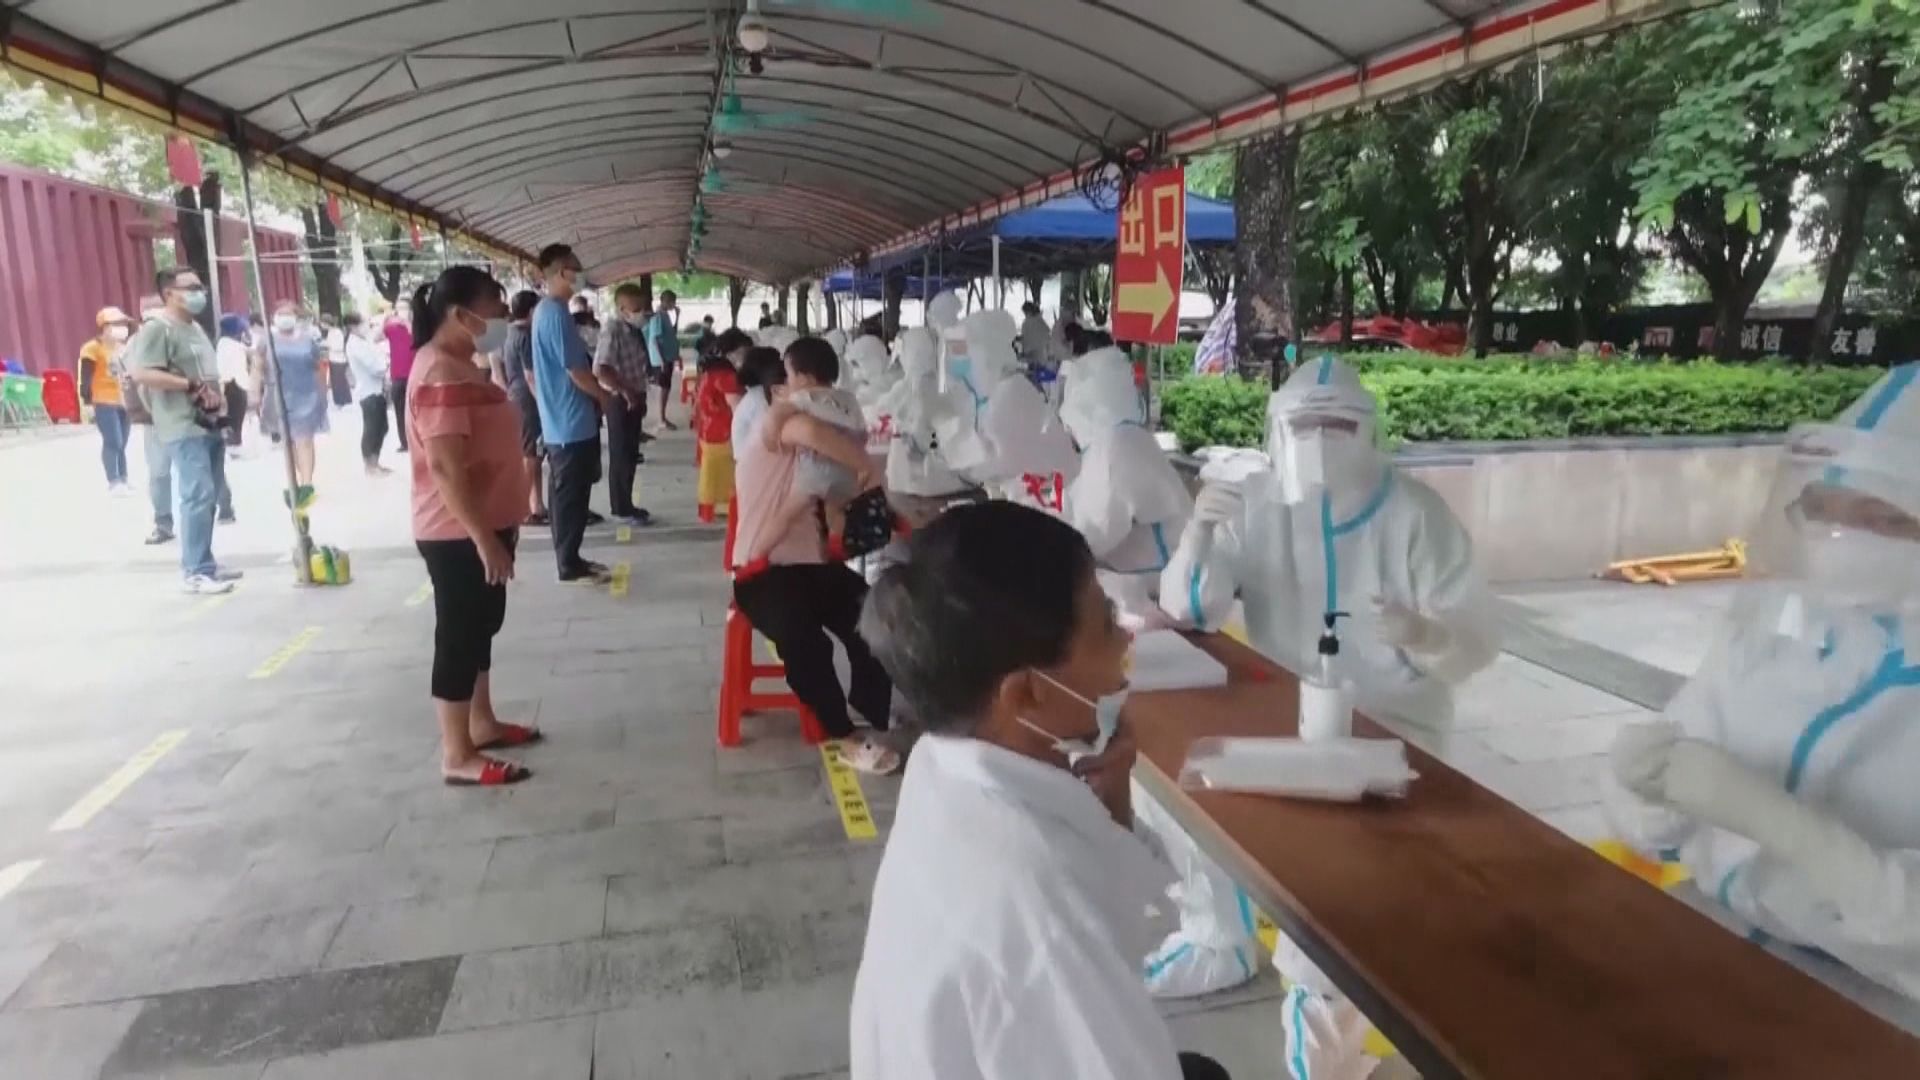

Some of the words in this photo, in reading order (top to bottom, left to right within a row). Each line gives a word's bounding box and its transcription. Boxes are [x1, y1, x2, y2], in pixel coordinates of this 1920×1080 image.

[1119, 183, 1180, 257] 出口
[1740, 325, 1783, 351] 诚信
[1831, 326, 1877, 356] 友善
